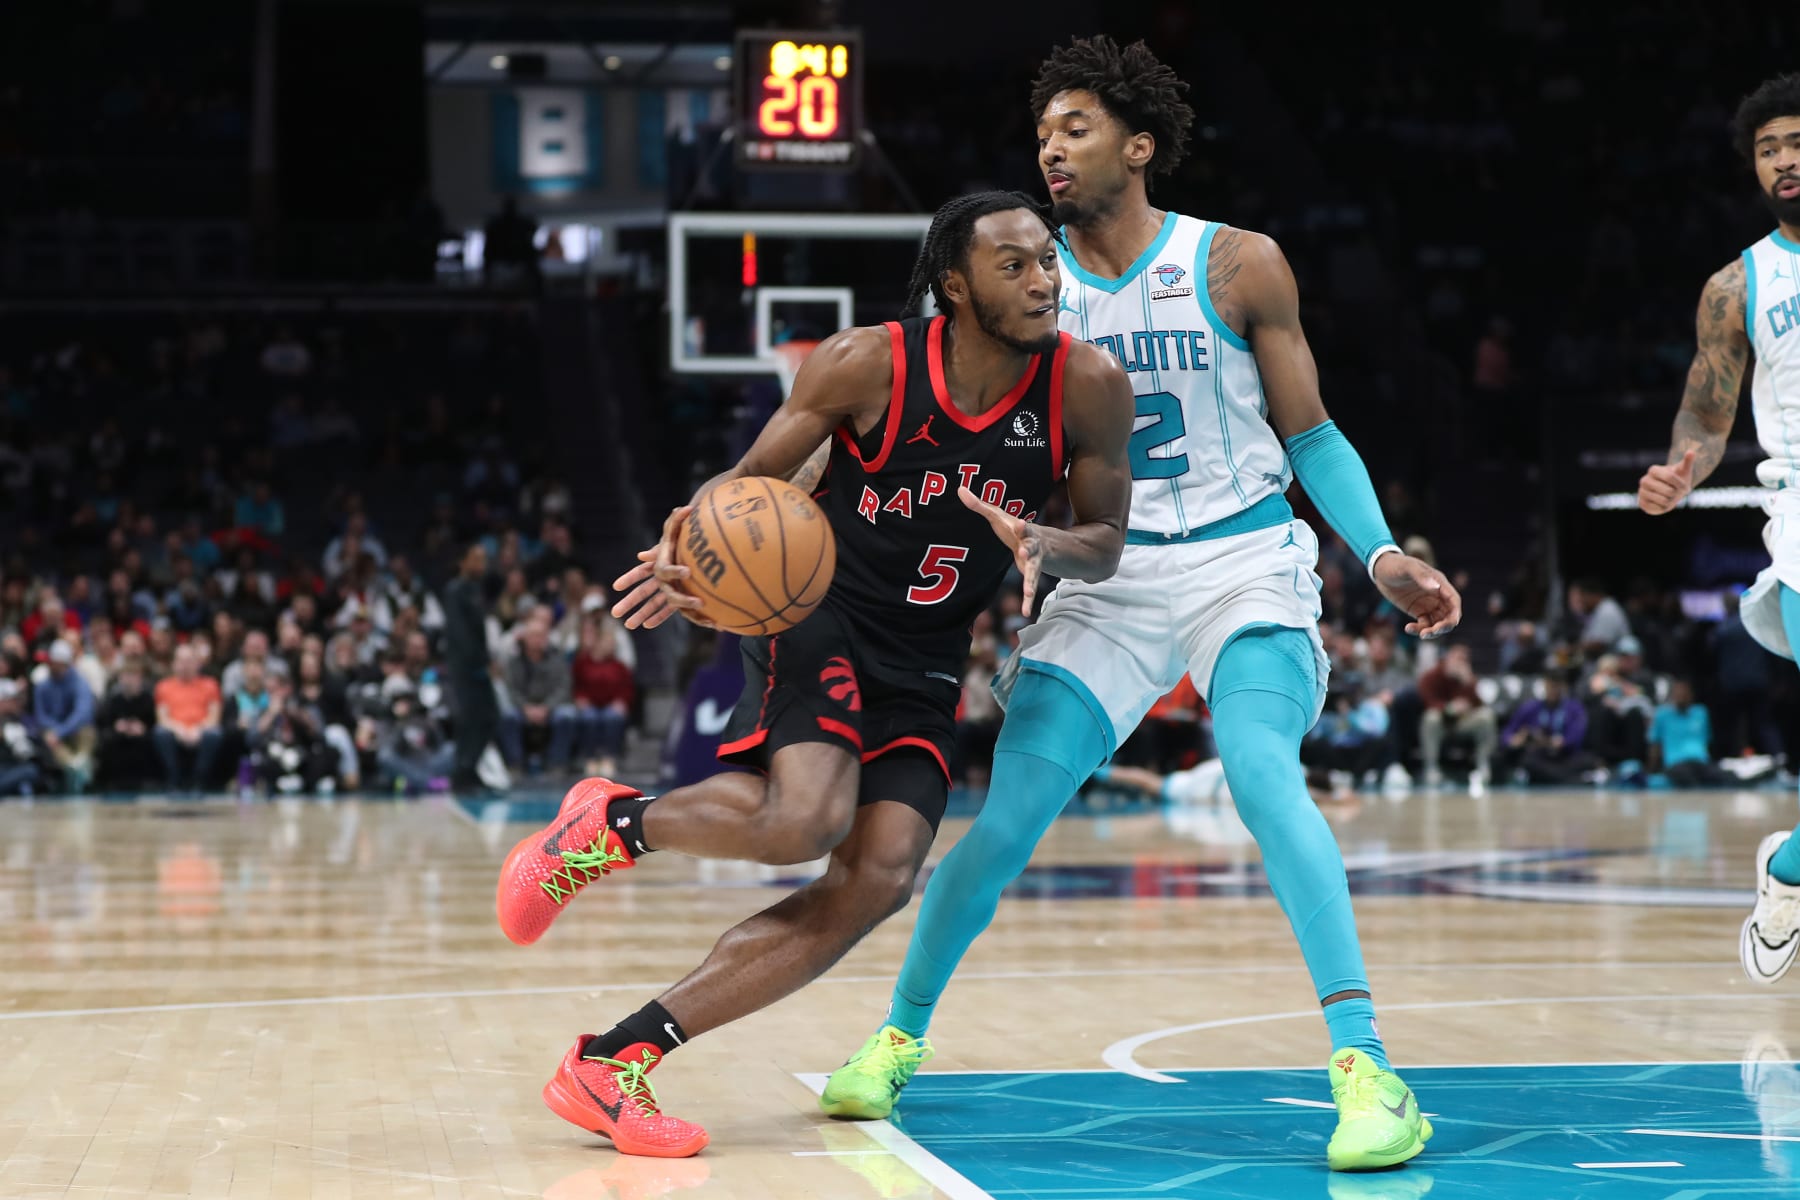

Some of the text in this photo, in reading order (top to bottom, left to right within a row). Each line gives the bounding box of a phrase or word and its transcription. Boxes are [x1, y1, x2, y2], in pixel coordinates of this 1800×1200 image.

[758, 75, 839, 138] 20
[1151, 288, 1193, 300] FEASTABLES
[1767, 294, 1800, 339] CH
[1004, 437, 1046, 447] Sun Life
[906, 544, 969, 605] 5
